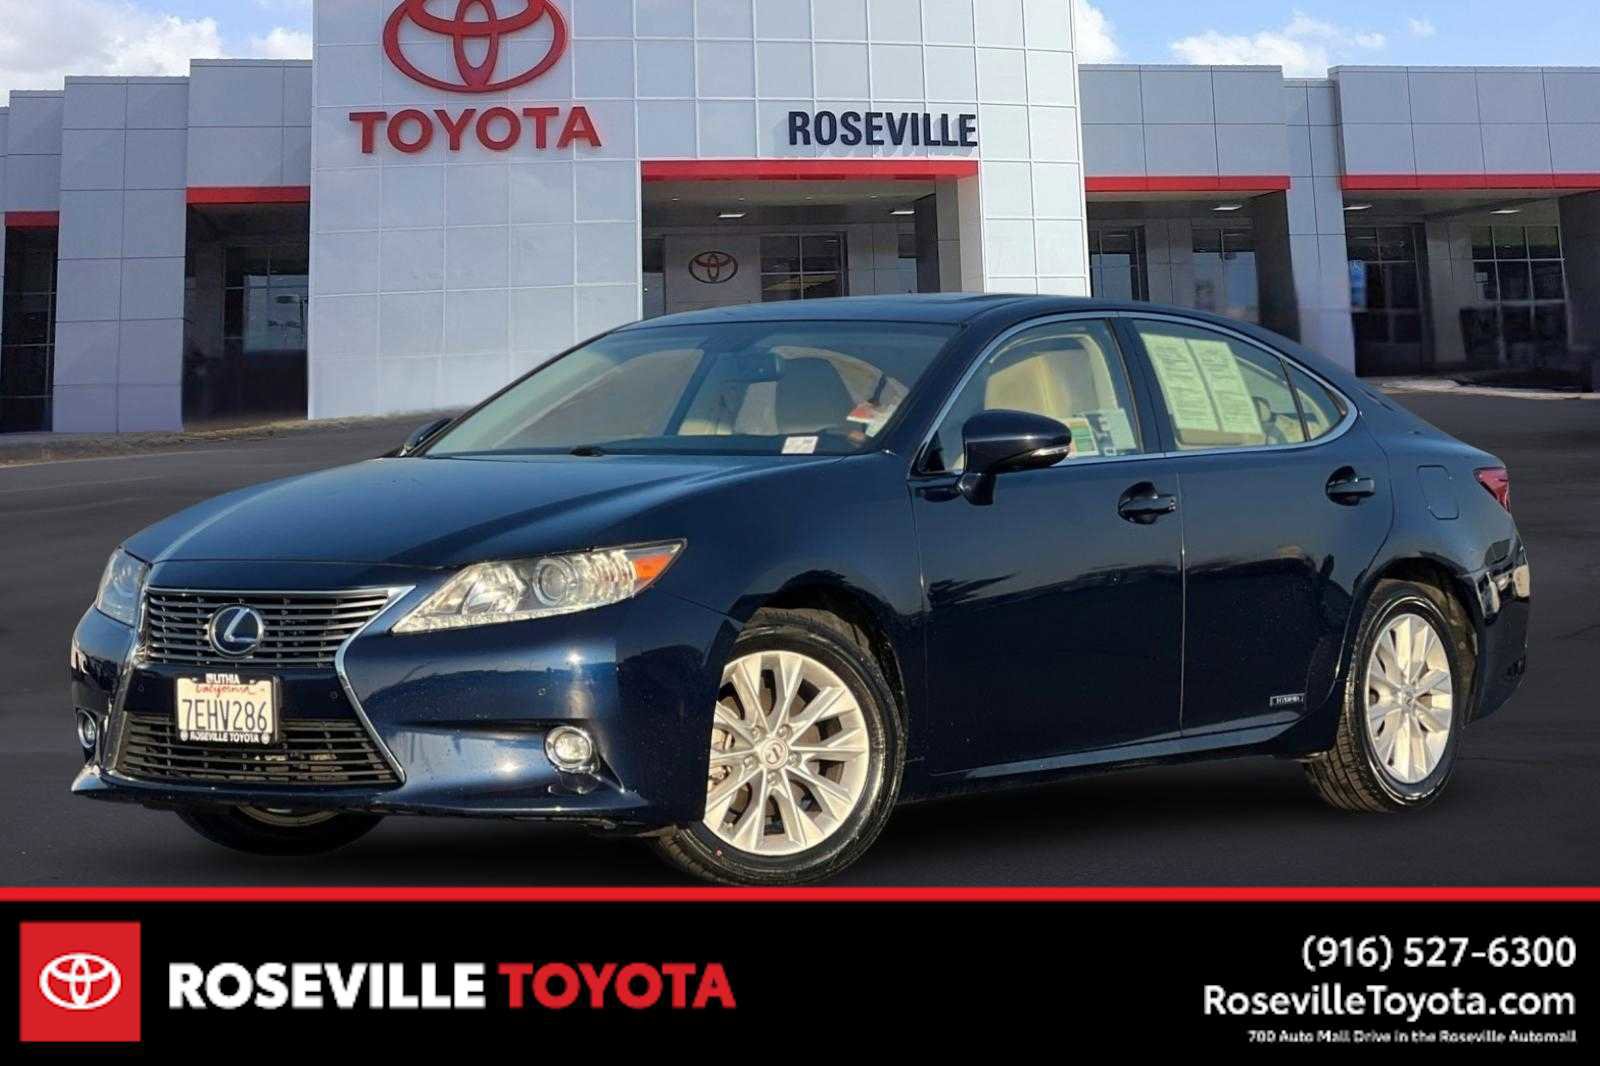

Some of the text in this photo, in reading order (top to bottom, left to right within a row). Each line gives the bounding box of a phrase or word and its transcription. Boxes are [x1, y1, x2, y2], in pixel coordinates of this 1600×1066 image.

[349, 106, 602, 154] TOYOTA
[788, 110, 978, 146] ROSEVILLE
[182, 699, 268, 732] 7EHV286
[190, 731, 260, 743] ROSEVILLE TOYOTA
